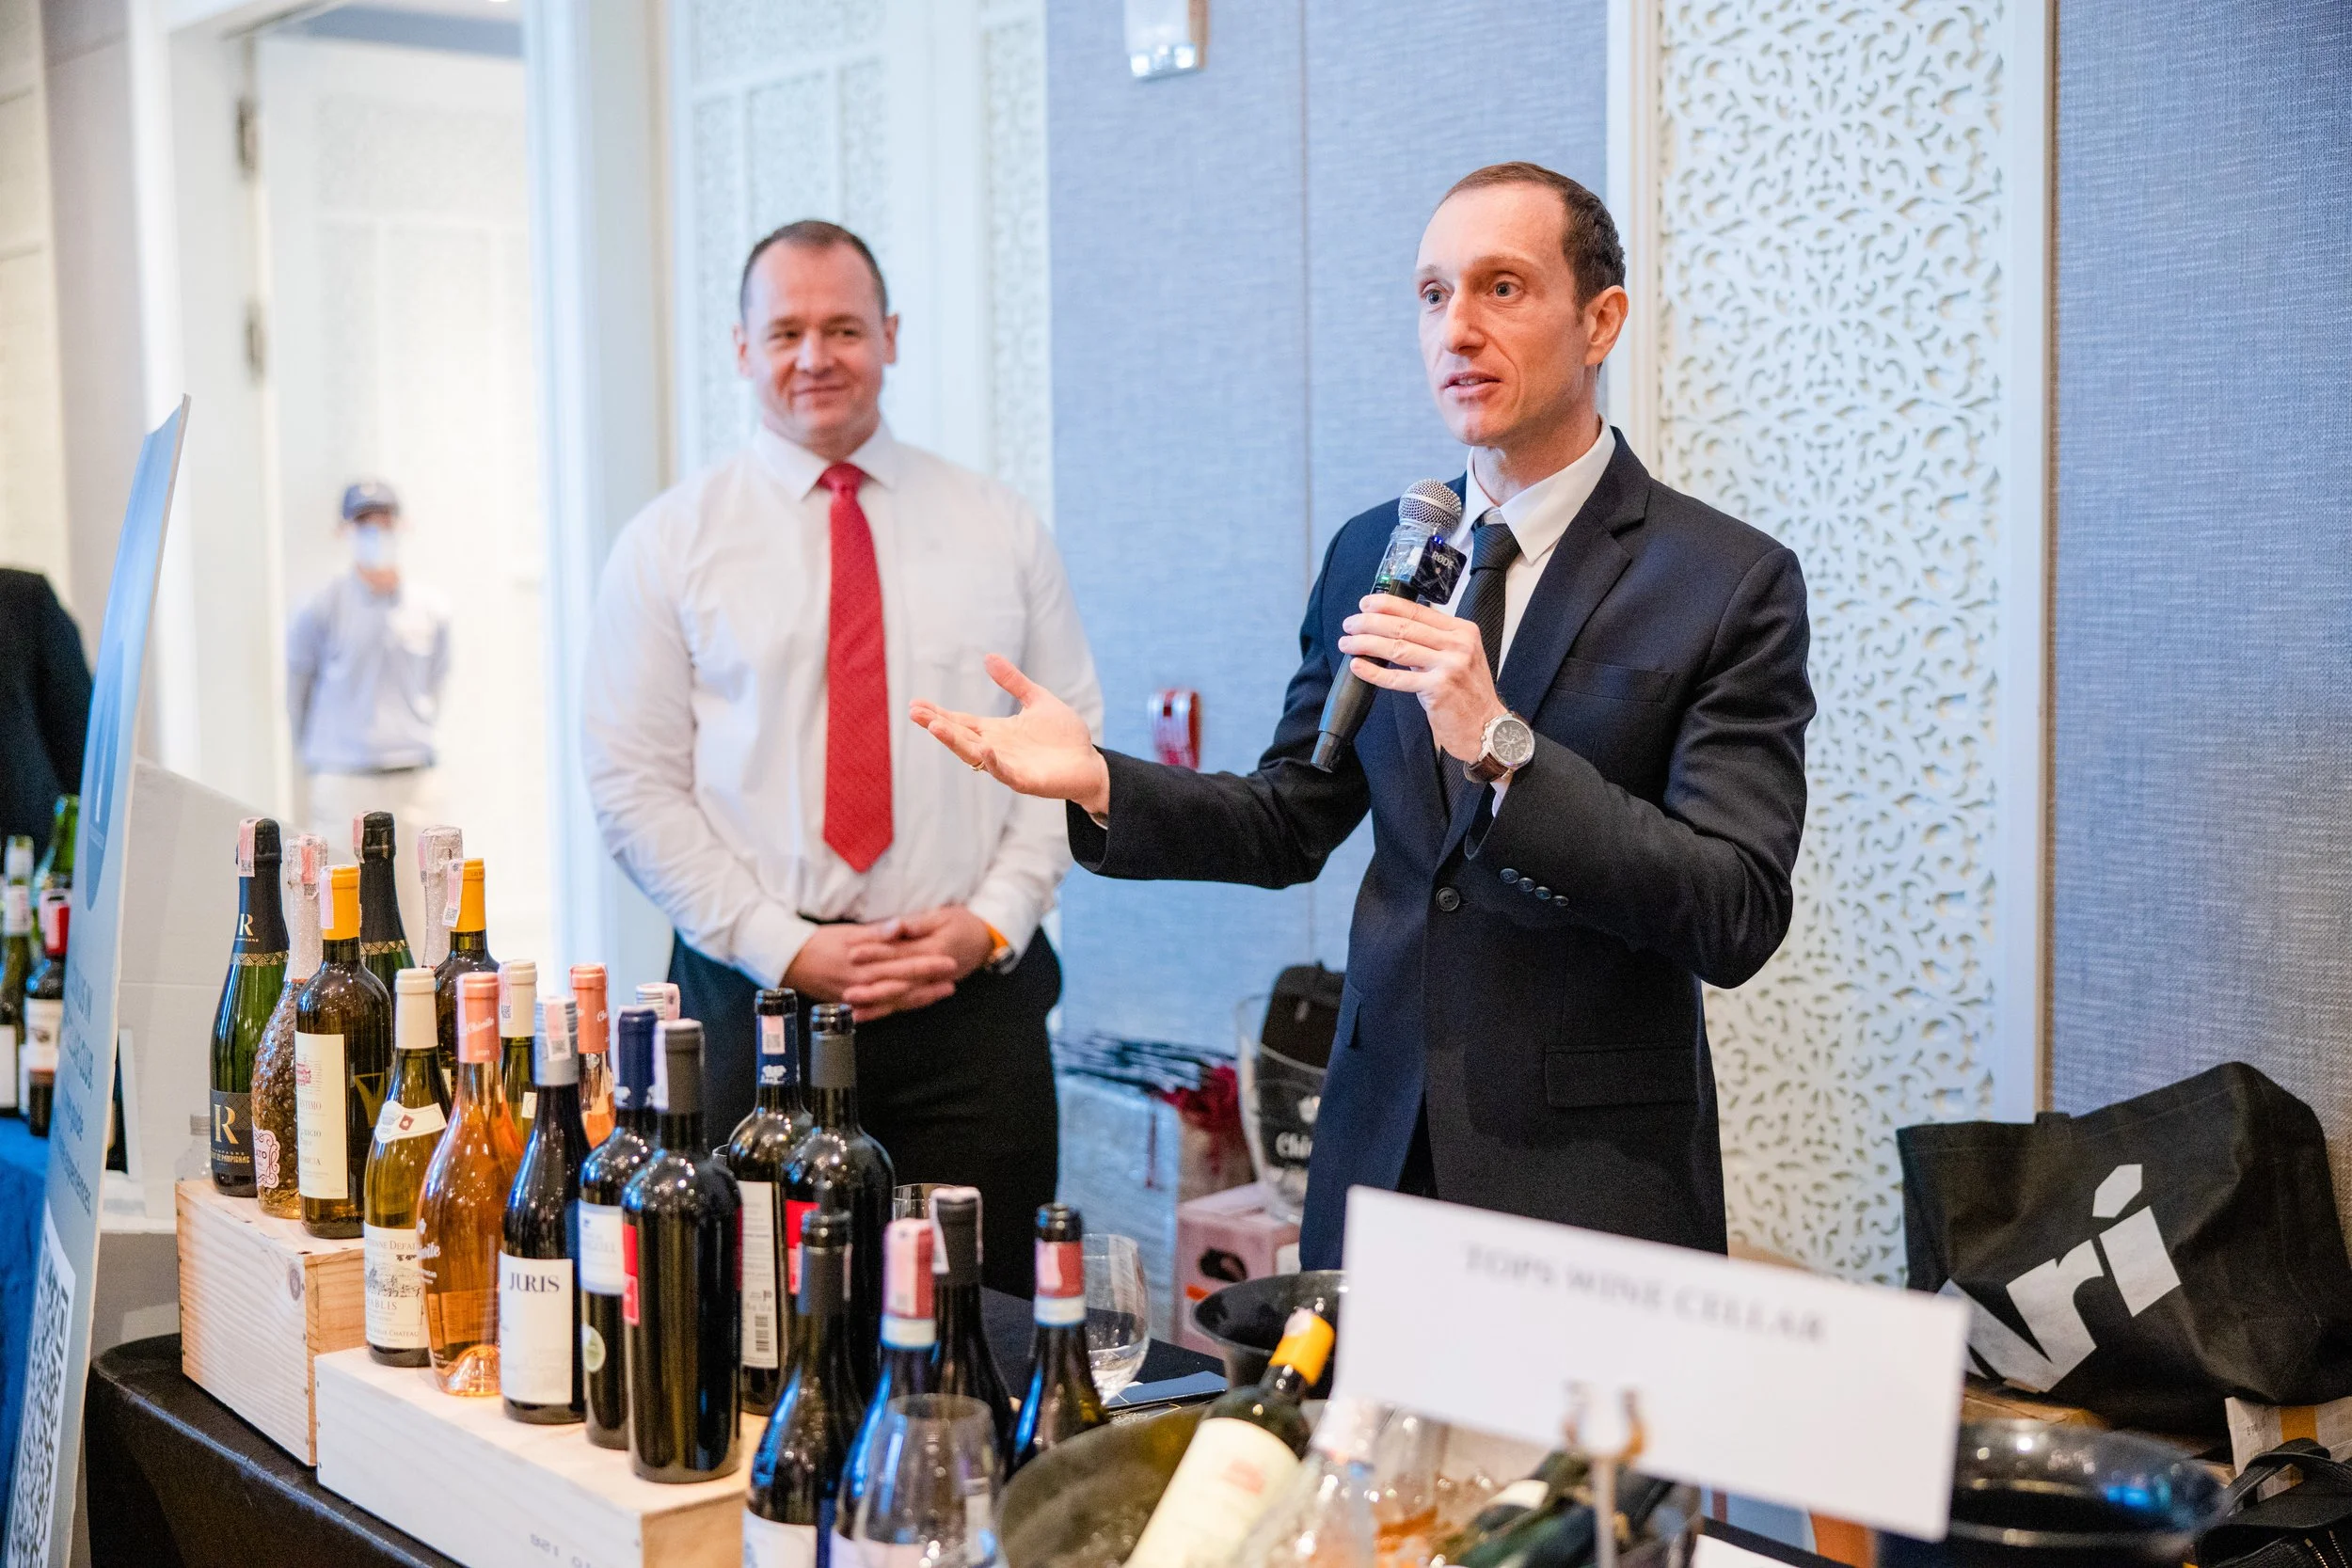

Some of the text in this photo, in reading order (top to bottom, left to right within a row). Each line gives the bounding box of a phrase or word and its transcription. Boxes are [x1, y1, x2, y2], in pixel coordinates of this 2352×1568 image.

[239, 913, 254, 936] R
[214, 1103, 240, 1145] R
[509, 1272, 560, 1293] JURIS
[1464, 1241, 1558, 1286] TOPS
[1673, 1283, 1828, 1346] CELLAR
